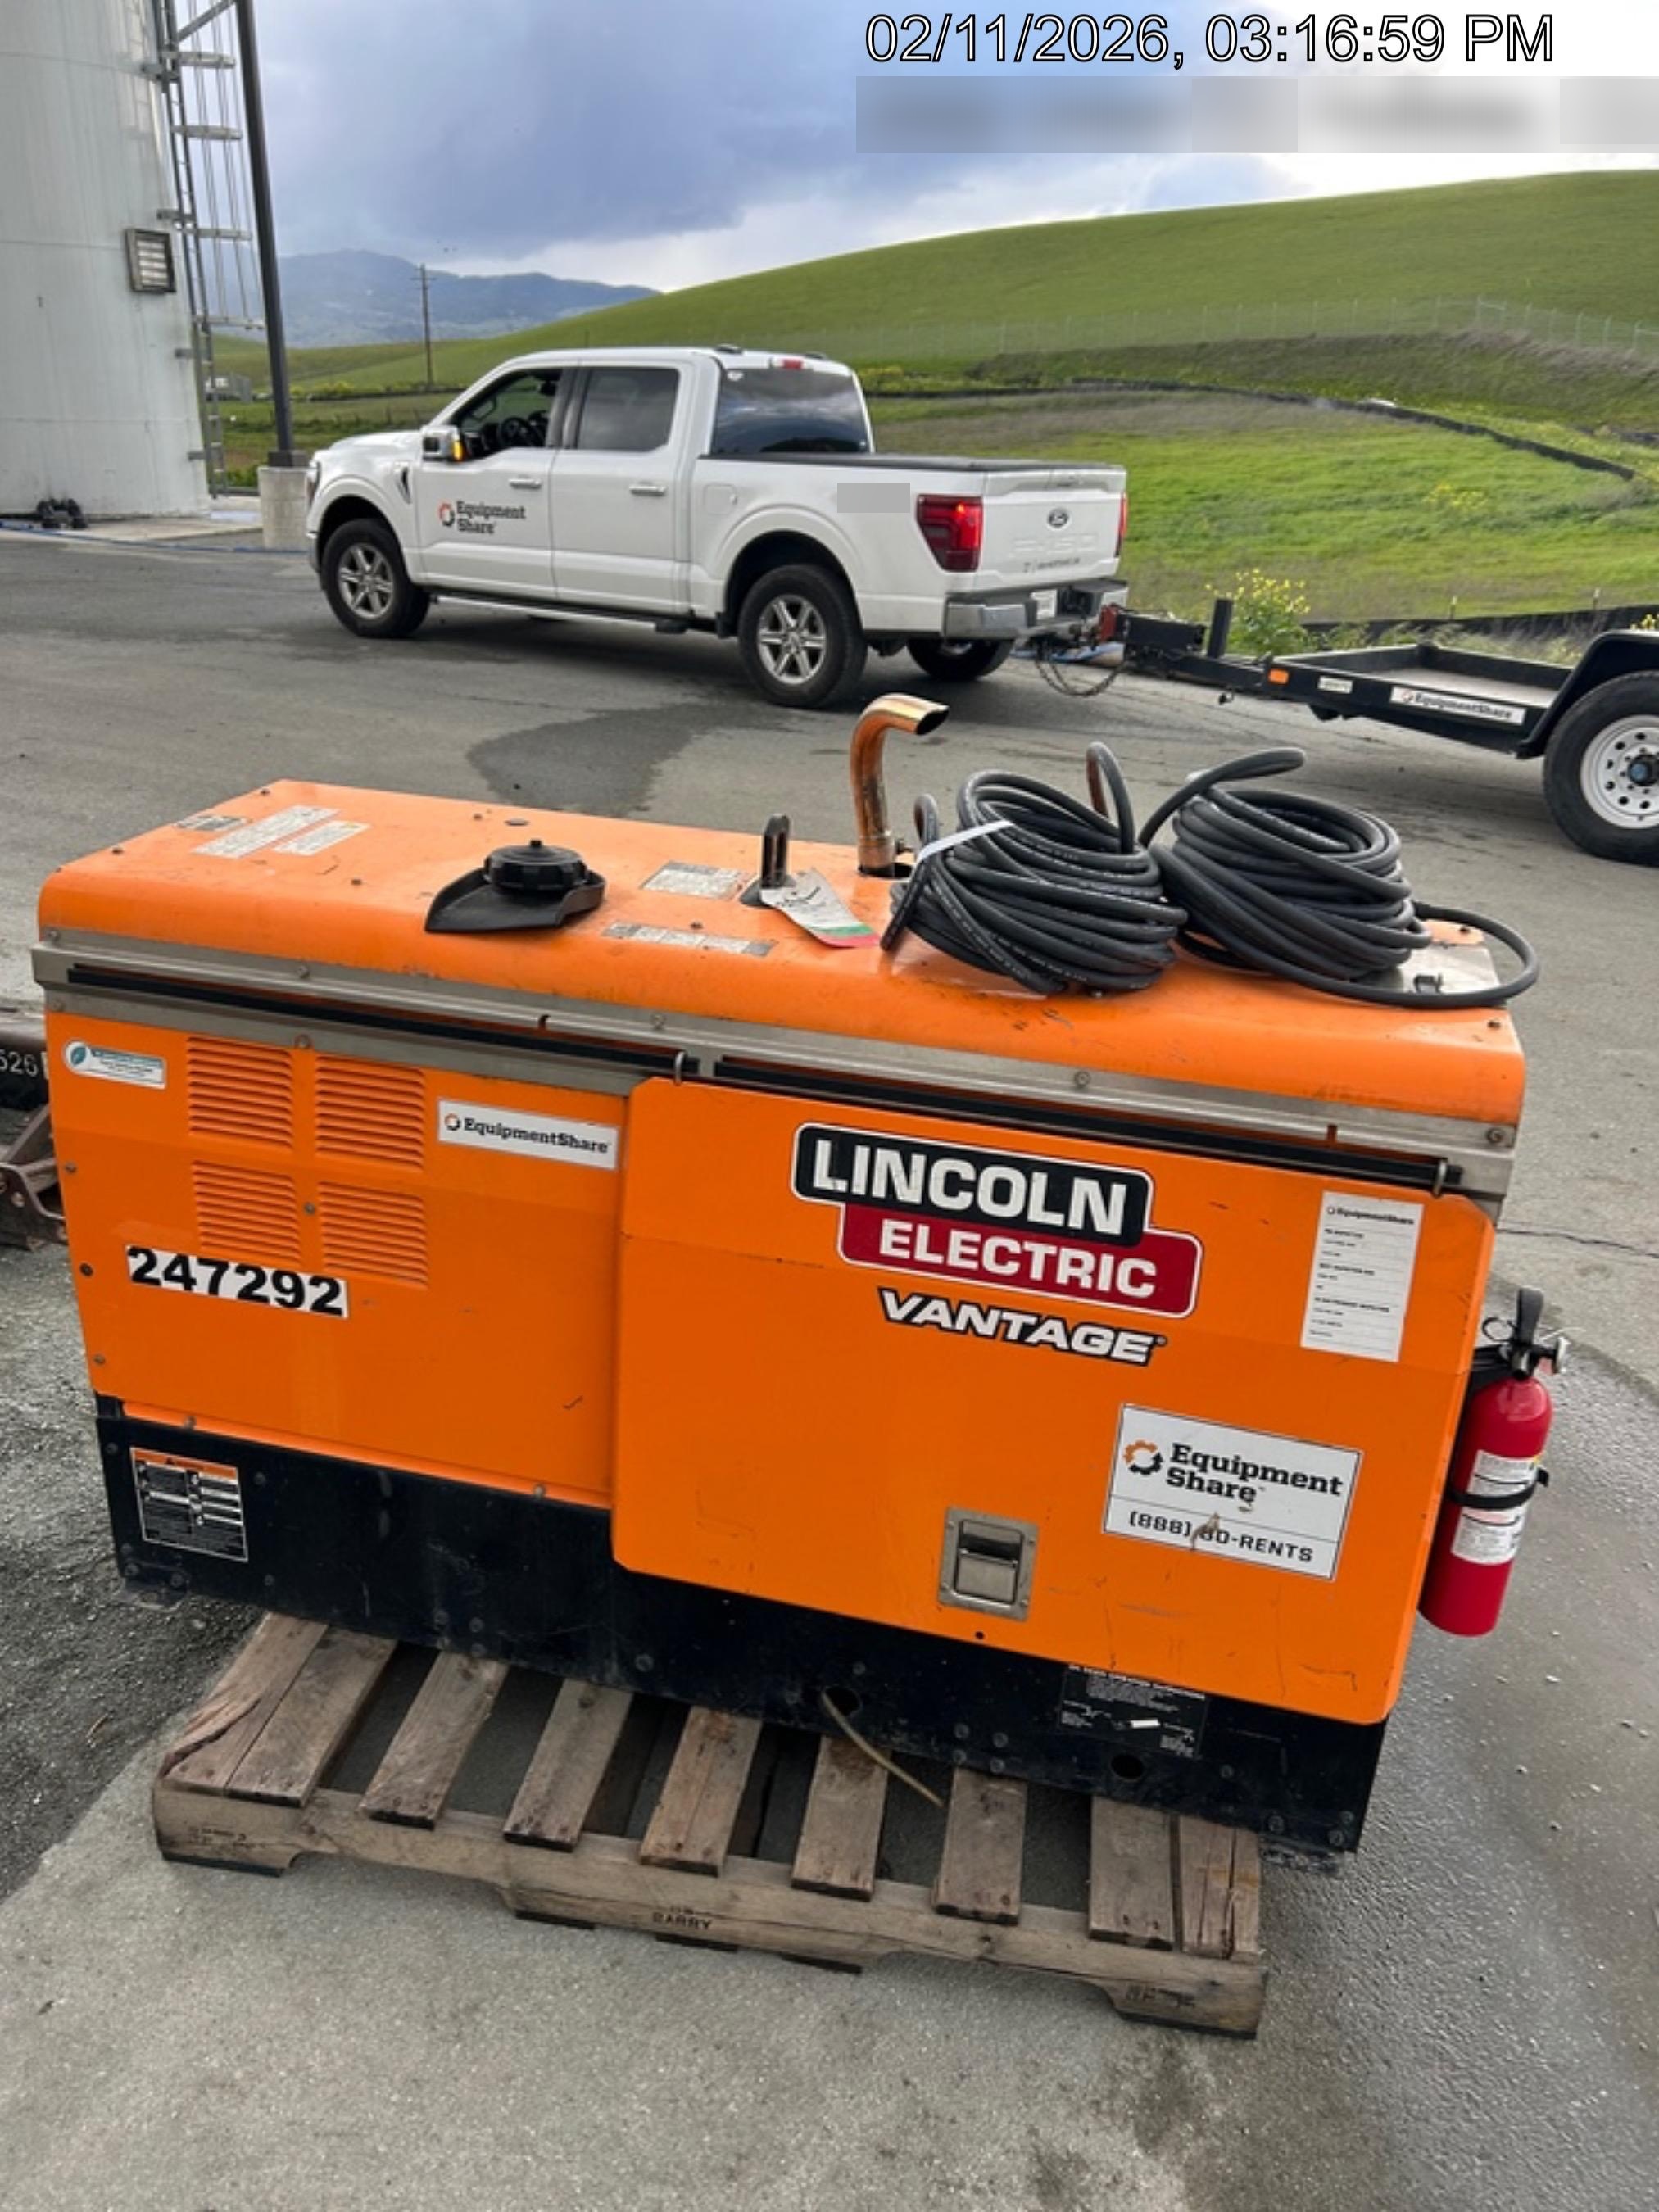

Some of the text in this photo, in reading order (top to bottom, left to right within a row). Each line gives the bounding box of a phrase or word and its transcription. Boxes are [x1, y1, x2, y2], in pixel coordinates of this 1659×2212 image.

[456, 501, 527, 520] Equipment
[457, 518, 495, 534] Share
[464, 1117, 609, 1154] EquipmentShare
[812, 1139, 1127, 1235] LINCOLN
[879, 1218, 1158, 1298] ELECTRIC
[126, 1245, 343, 1317] 247292
[1166, 1466, 1258, 1503] Share
[1169, 1443, 1344, 1496] Equipment
[1129, 1511, 1193, 1538] (888)
